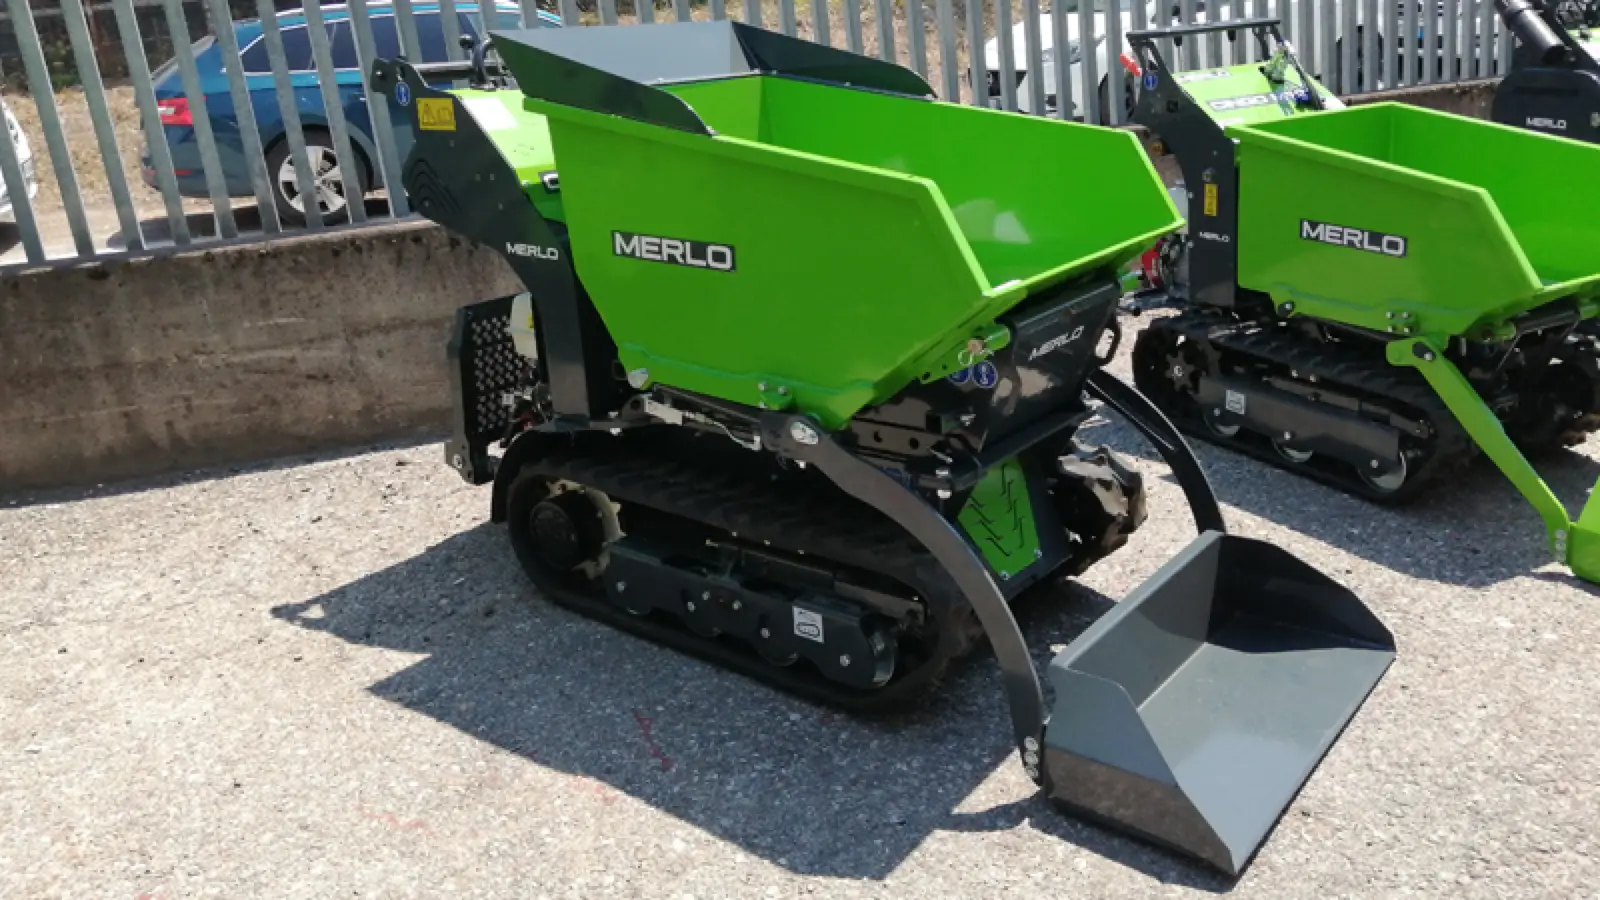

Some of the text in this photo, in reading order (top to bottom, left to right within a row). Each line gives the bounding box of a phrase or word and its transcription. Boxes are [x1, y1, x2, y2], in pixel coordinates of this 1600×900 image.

[505, 242, 559, 260] MERLO
[613, 231, 732, 269] MERLO
[1302, 221, 1405, 255] MERLO
